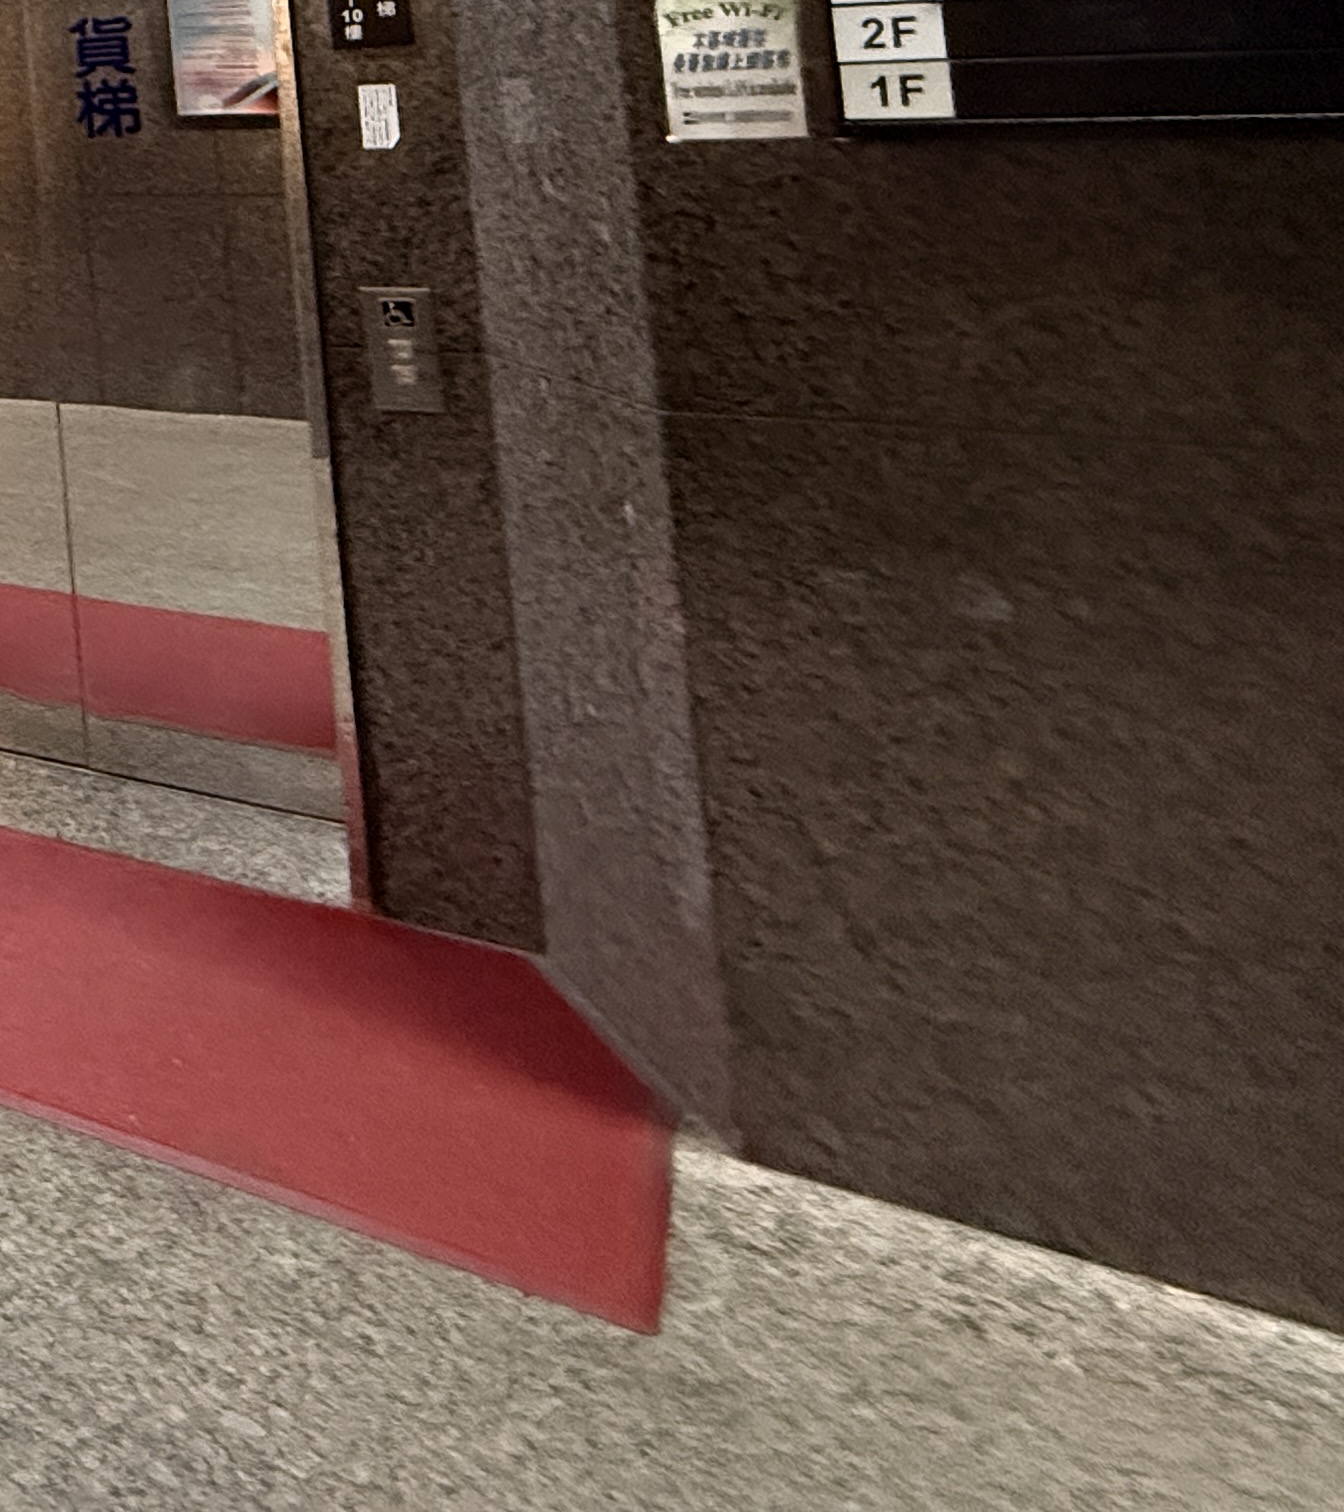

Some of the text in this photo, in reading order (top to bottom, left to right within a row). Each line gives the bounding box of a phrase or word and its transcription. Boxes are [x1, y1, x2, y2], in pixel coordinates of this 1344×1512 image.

[664, 1, 790, 28] Free Wi-Fi
[862, 15, 917, 50] 2F
[67, 15, 142, 138] 貨梯
[870, 75, 925, 109] 1F
